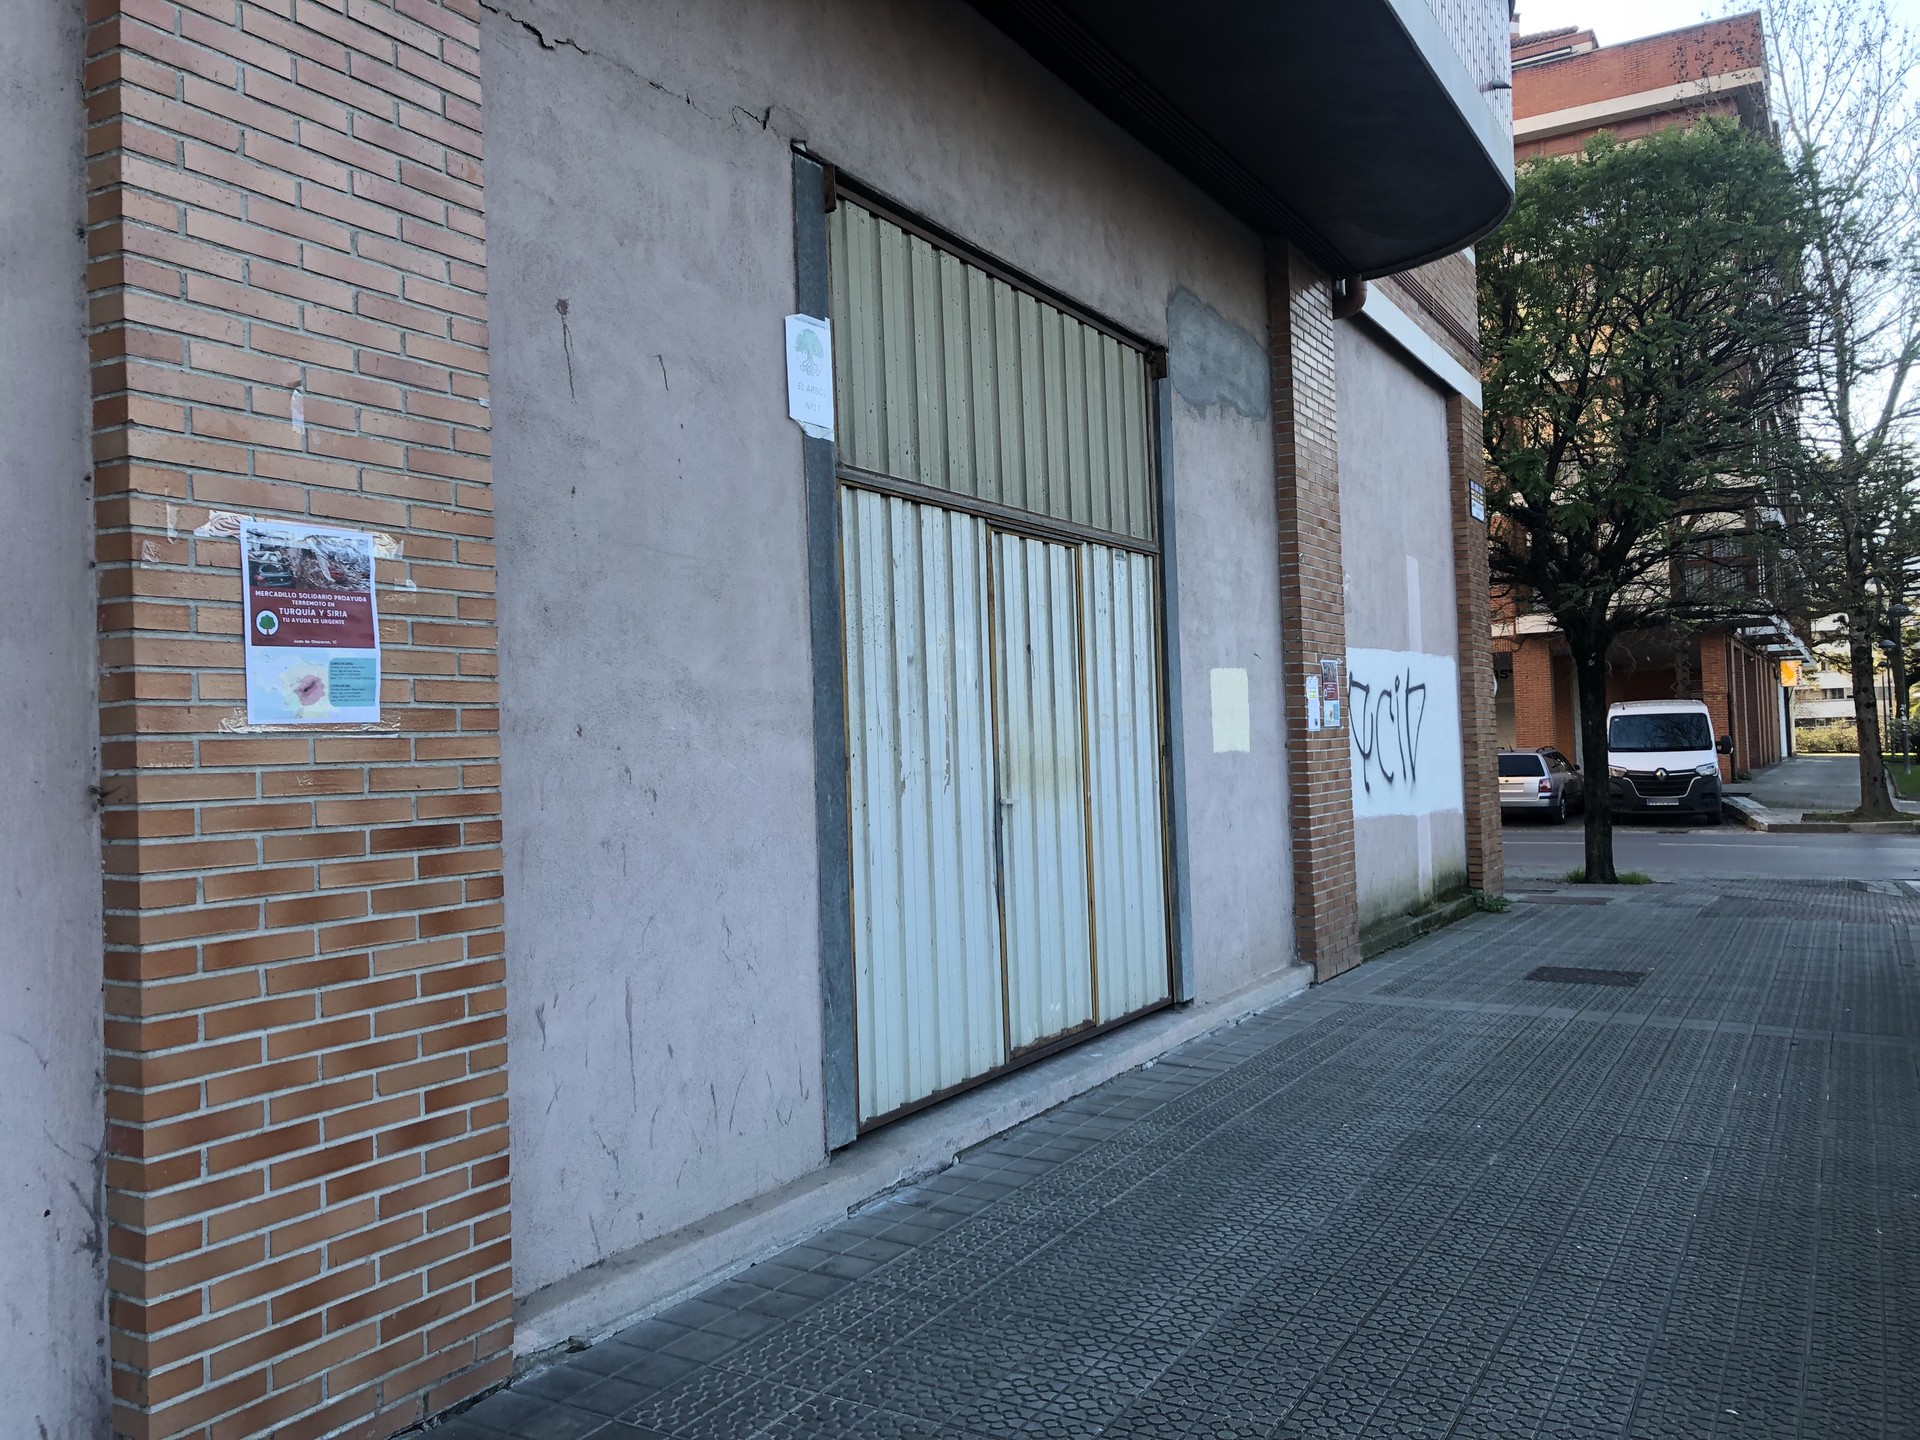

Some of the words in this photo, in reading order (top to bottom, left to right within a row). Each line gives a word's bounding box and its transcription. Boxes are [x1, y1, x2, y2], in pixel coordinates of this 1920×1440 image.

[798, 381, 805, 391] EL
[334, 594, 367, 602] PROAYUDA
[279, 607, 316, 616] TURQUÍA
[327, 610, 348, 618] SIRIA
